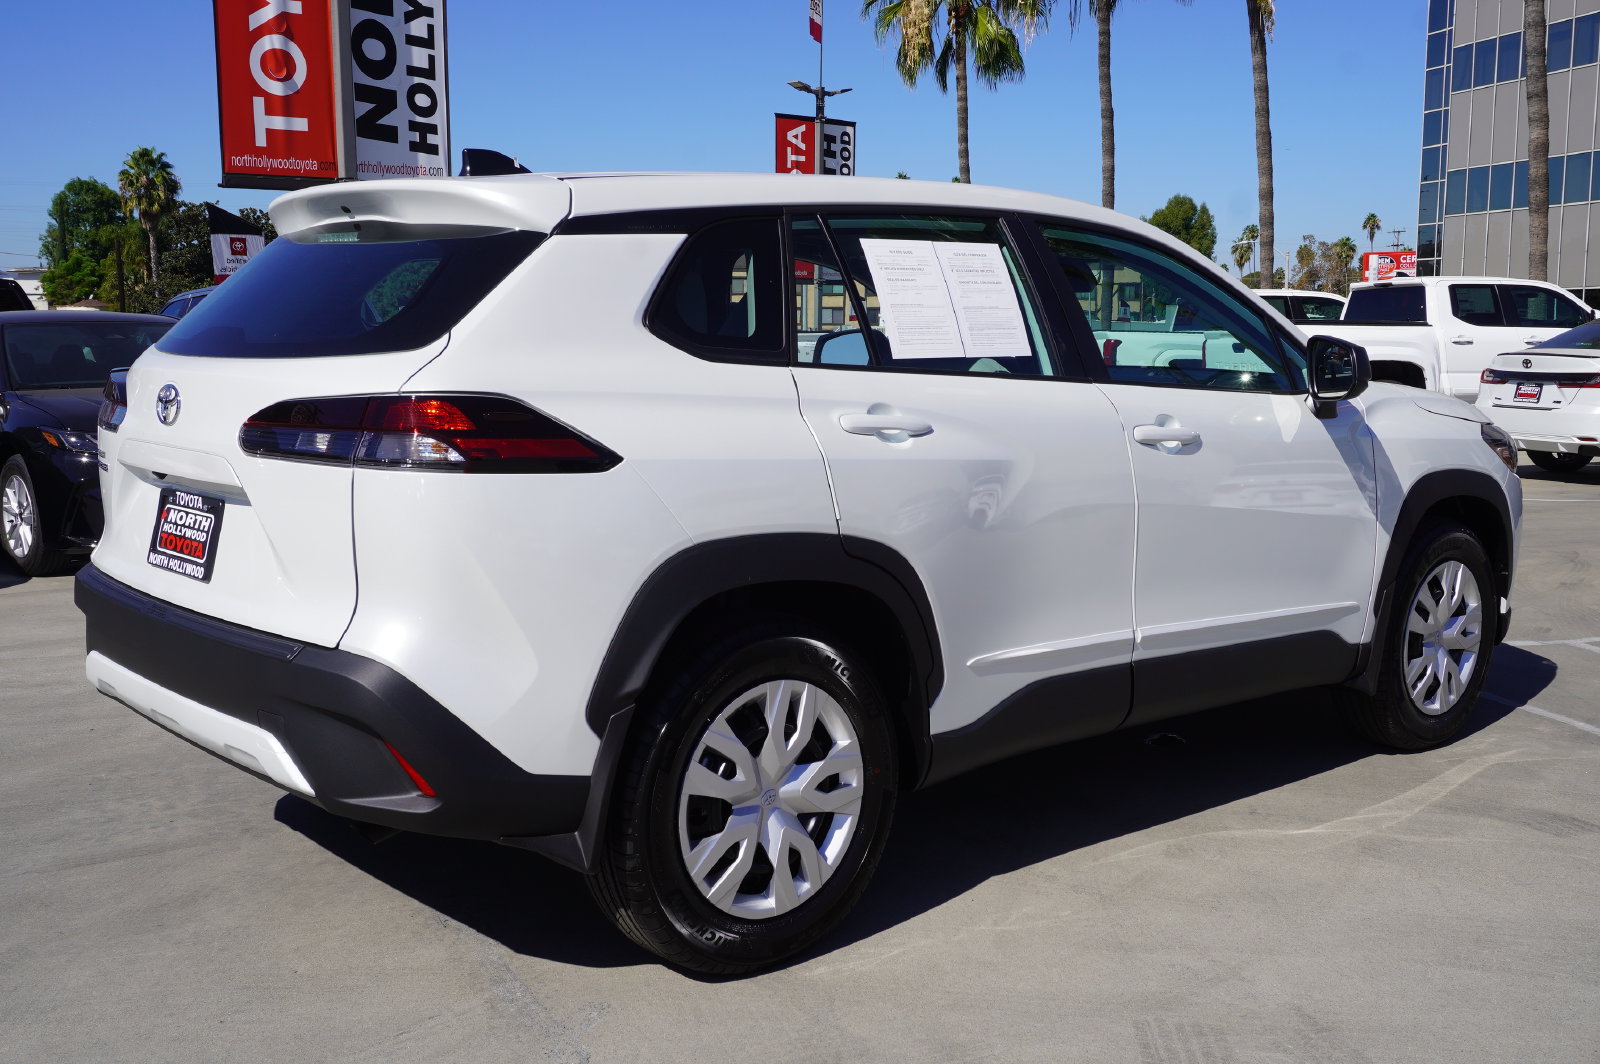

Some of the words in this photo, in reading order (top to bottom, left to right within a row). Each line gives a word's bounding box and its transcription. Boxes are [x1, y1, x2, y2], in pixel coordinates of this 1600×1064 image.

[787, 124, 806, 174] TA
[357, 161, 444, 178] rthhollywoodtoyota.com
[176, 491, 203, 510] TOYOTA
[162, 522, 207, 542] HOLLYWOOD
[168, 509, 211, 532] NORTH
[160, 532, 203, 559] TOYOTA
[148, 551, 169, 568] NORTH
[168, 559, 205, 579] HOLLYWOOD
